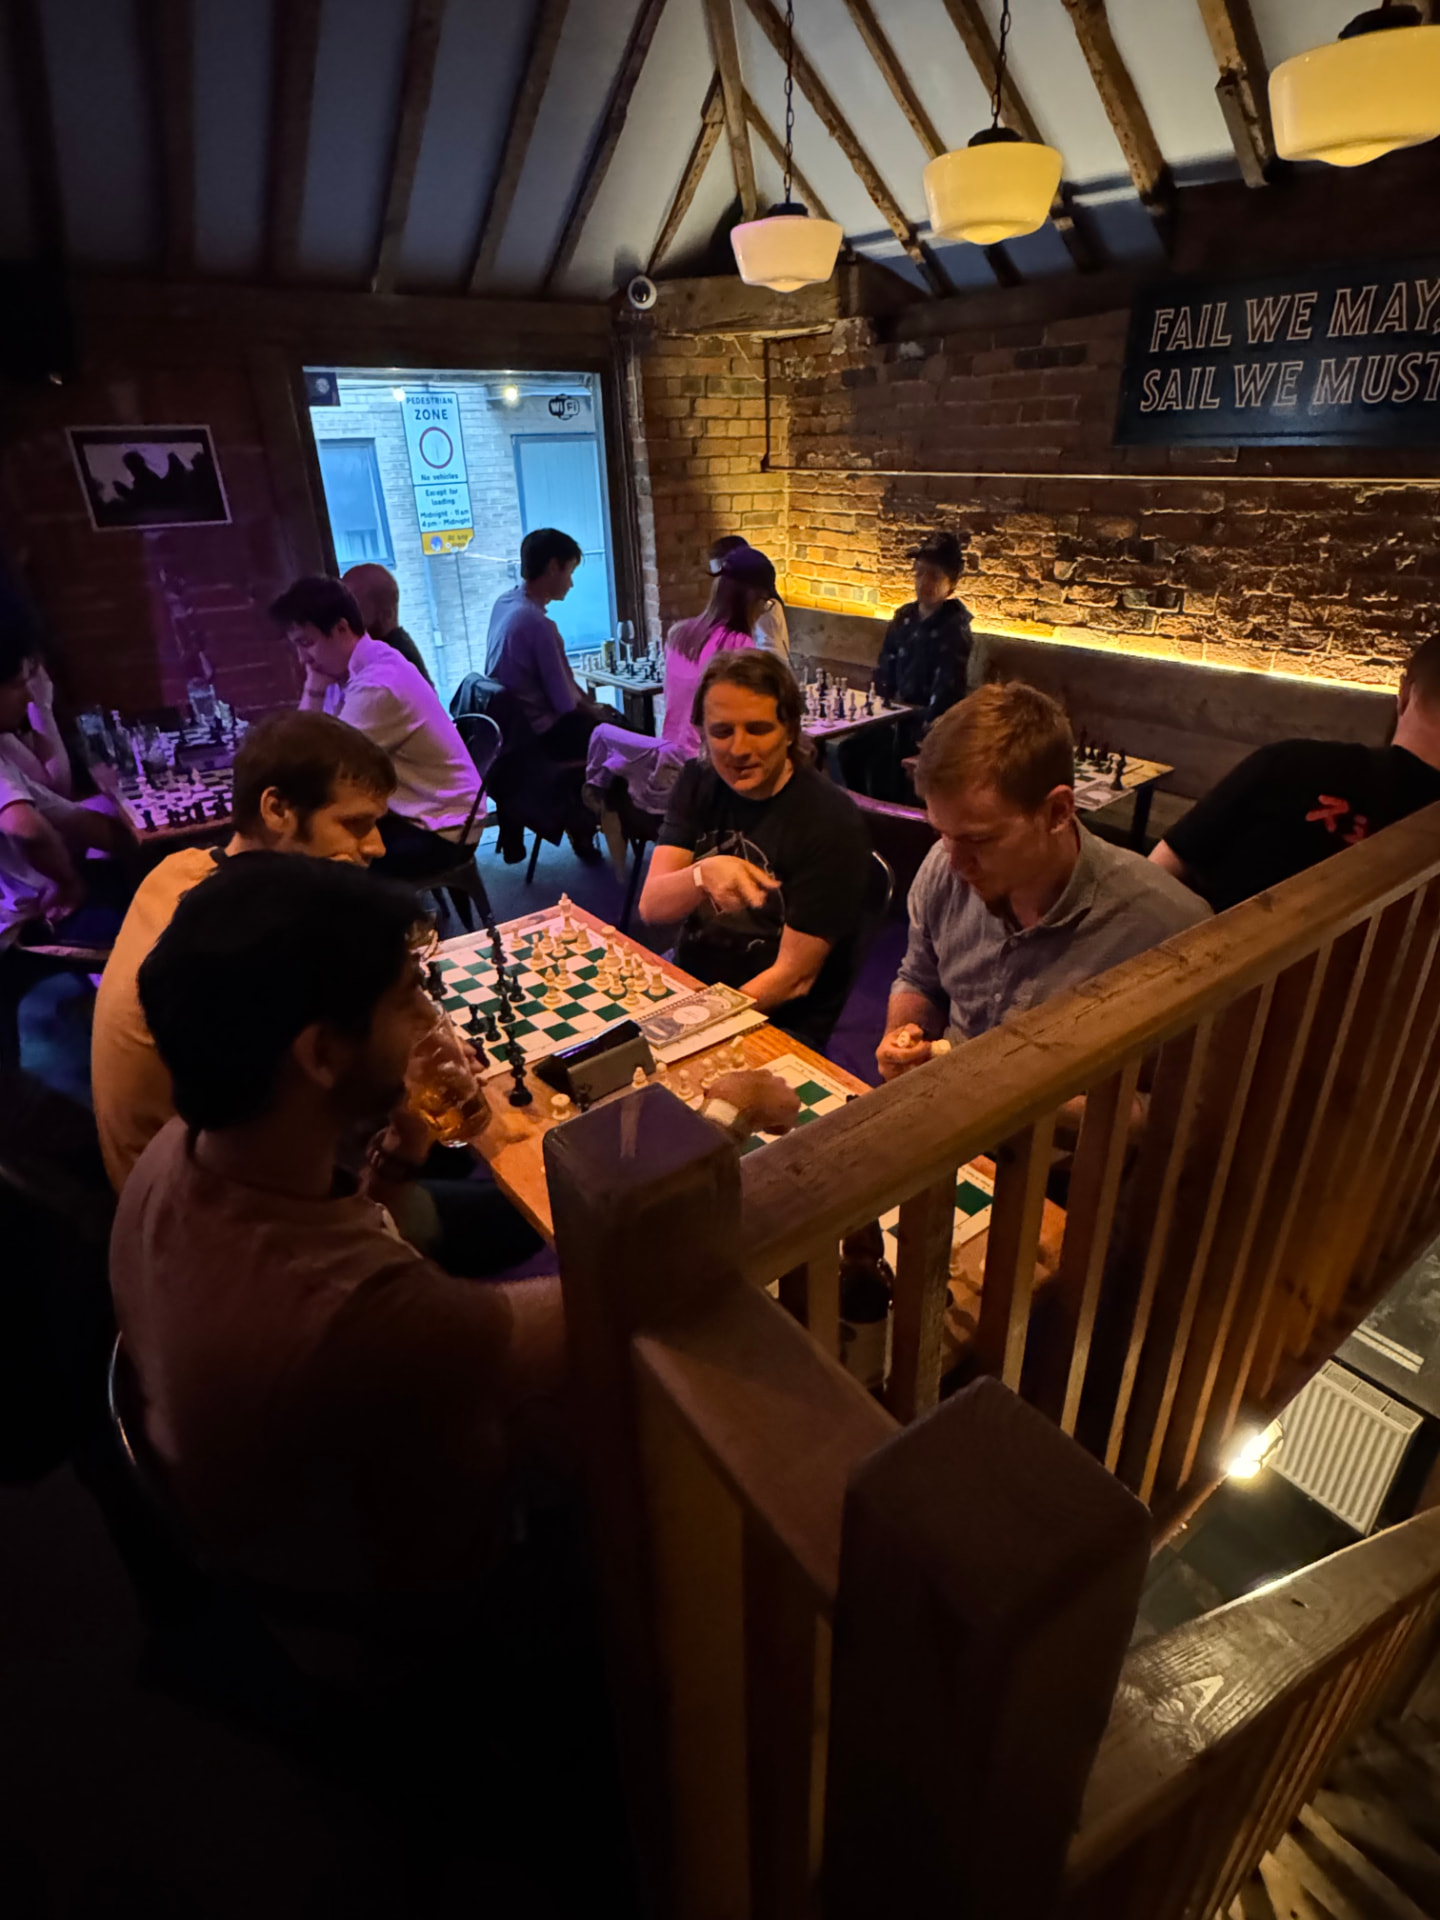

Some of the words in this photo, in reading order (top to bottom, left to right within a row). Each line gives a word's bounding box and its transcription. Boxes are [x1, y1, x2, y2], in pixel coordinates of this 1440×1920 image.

[1149, 301, 1232, 353] FAIL
[1246, 291, 1318, 344] WE
[1139, 366, 1221, 412] SAIL
[1233, 360, 1304, 409] WE
[1313, 352, 1440, 405] MUST
[414, 408, 449, 421] ZONE
[425, 488, 447, 497] Except
[431, 498, 455, 506] loading
[420, 510, 448, 519] Midnight
[443, 517, 470, 525] Midnight
